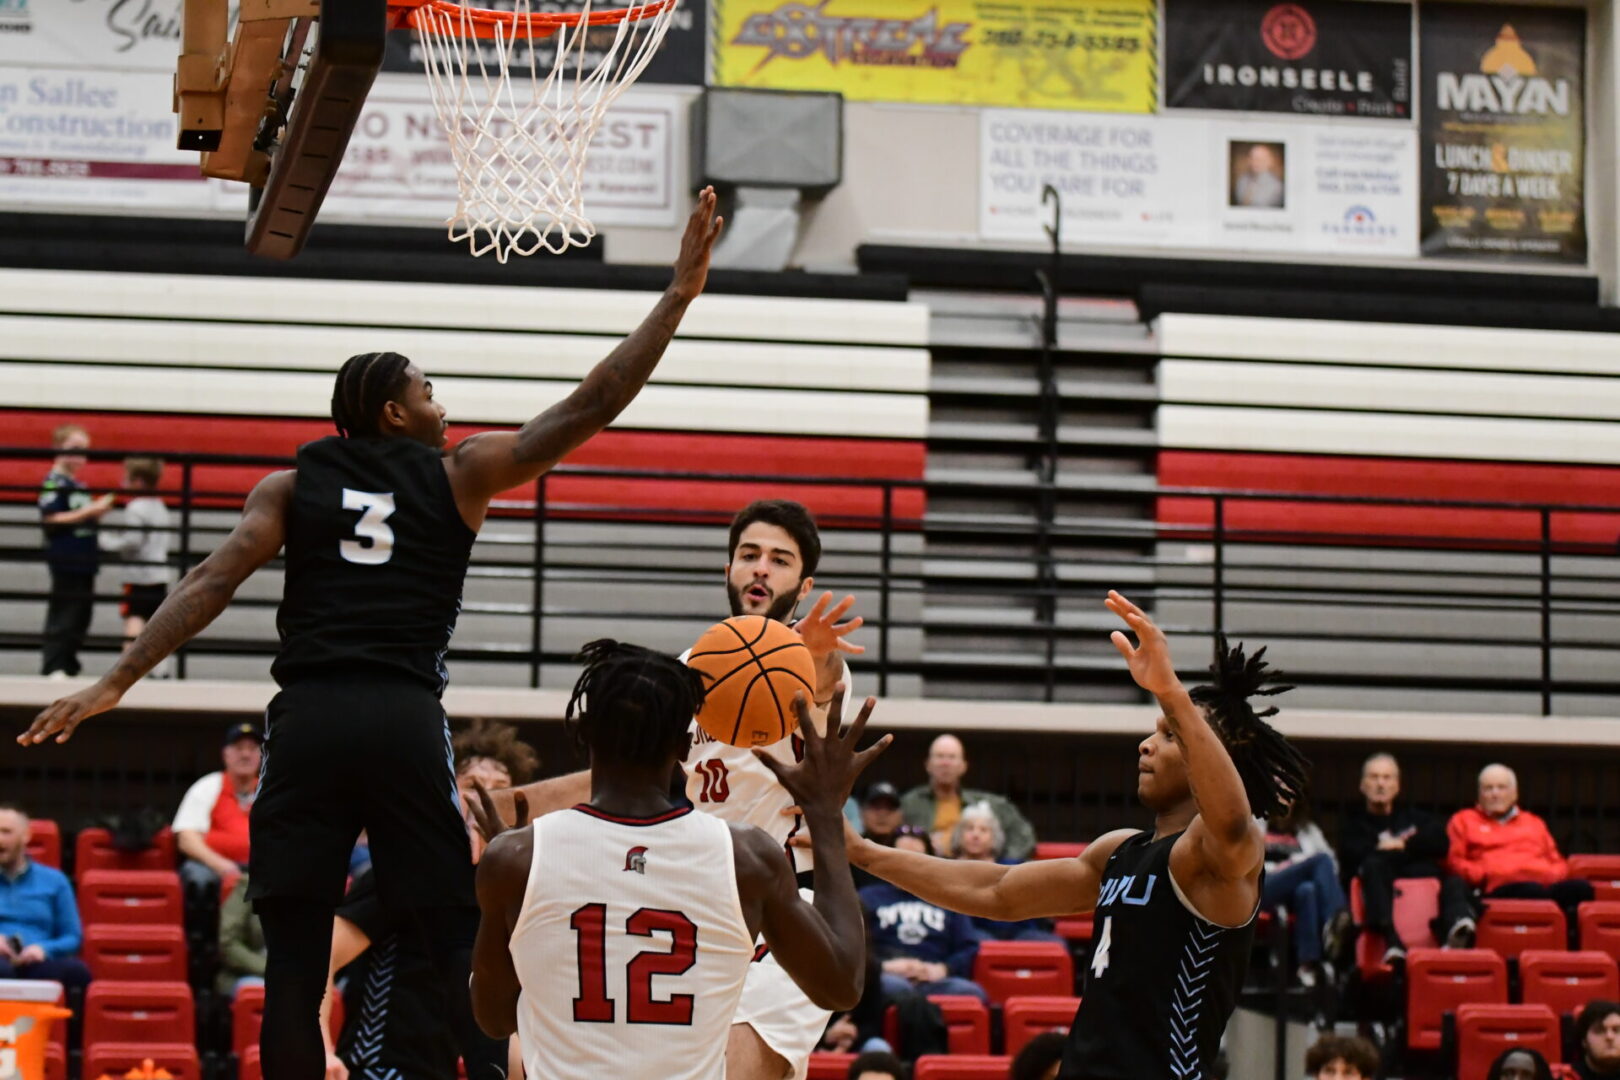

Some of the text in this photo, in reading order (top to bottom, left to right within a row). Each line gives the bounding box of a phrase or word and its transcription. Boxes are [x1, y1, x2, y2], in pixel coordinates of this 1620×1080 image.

[1203, 63, 1374, 92] IRONSEELE
[1436, 72, 1569, 115] MAYAN
[1, 112, 173, 139] onstruction
[990, 123, 1152, 148] COVERAGE FOR
[990, 149, 1158, 174] ALL THE THINGS
[1435, 143, 1492, 170] LUNCH
[1491, 142, 1509, 173] &
[1508, 147, 1572, 174] DINNER
[991, 173, 1034, 194] YOU
[1102, 175, 1145, 197] FOR
[1447, 172, 1561, 200] 7 DAYS A WEEK
[339, 488, 396, 565] 3
[694, 758, 730, 803] 10
[1090, 916, 1113, 979] 4
[570, 902, 698, 1026] 12
